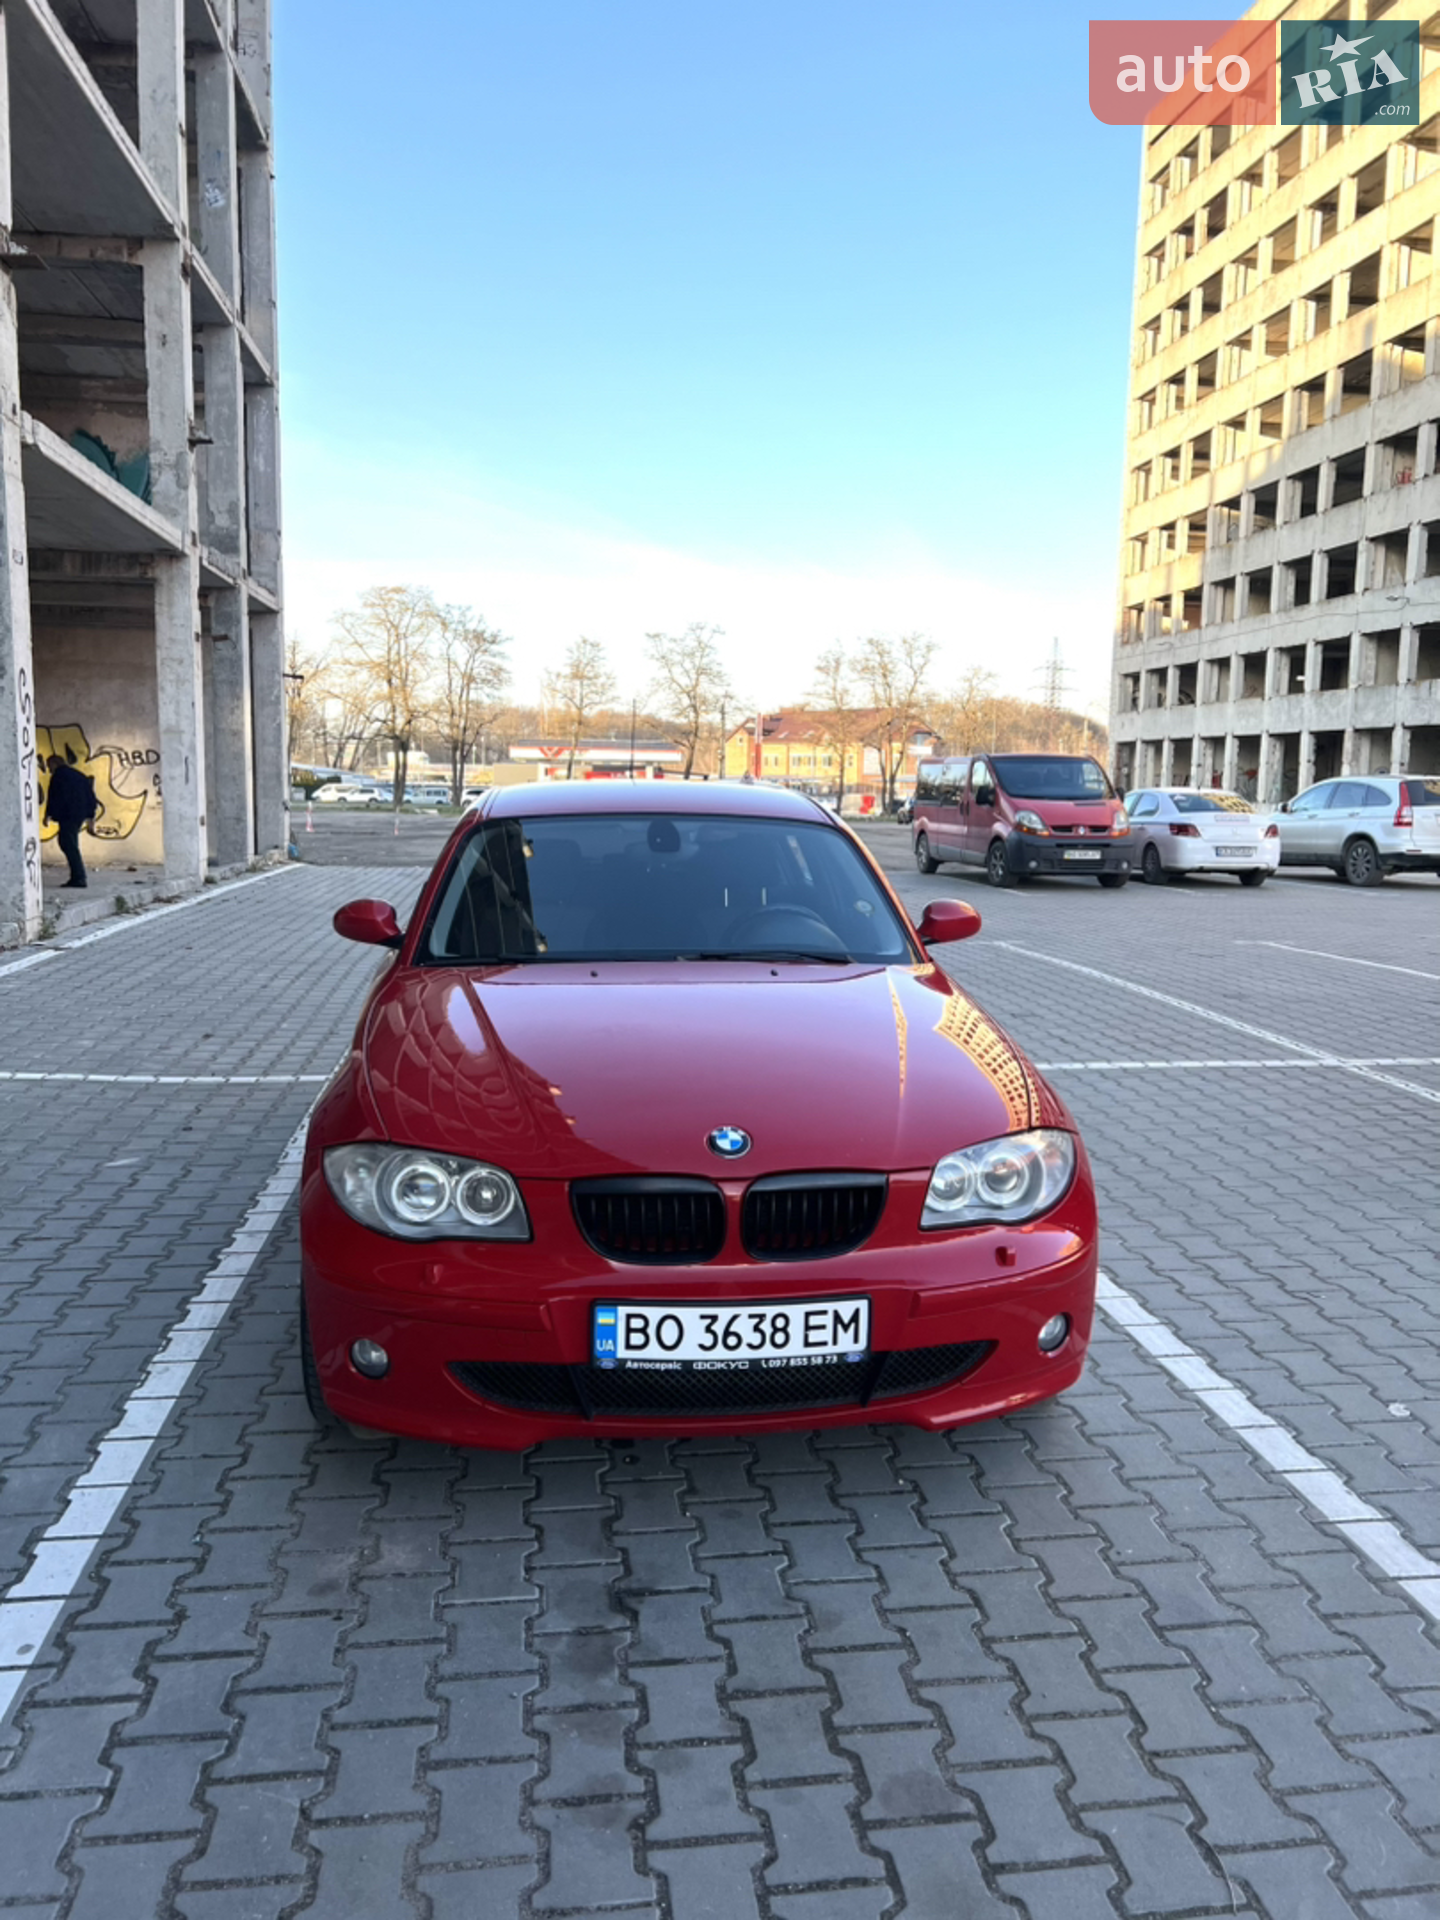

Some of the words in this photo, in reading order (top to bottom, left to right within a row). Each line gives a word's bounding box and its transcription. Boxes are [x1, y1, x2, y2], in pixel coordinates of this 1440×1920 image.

[624, 1313, 684, 1351] BO
[697, 1312, 790, 1352] 3638
[802, 1307, 860, 1348] EM
[597, 1339, 615, 1351] UA
